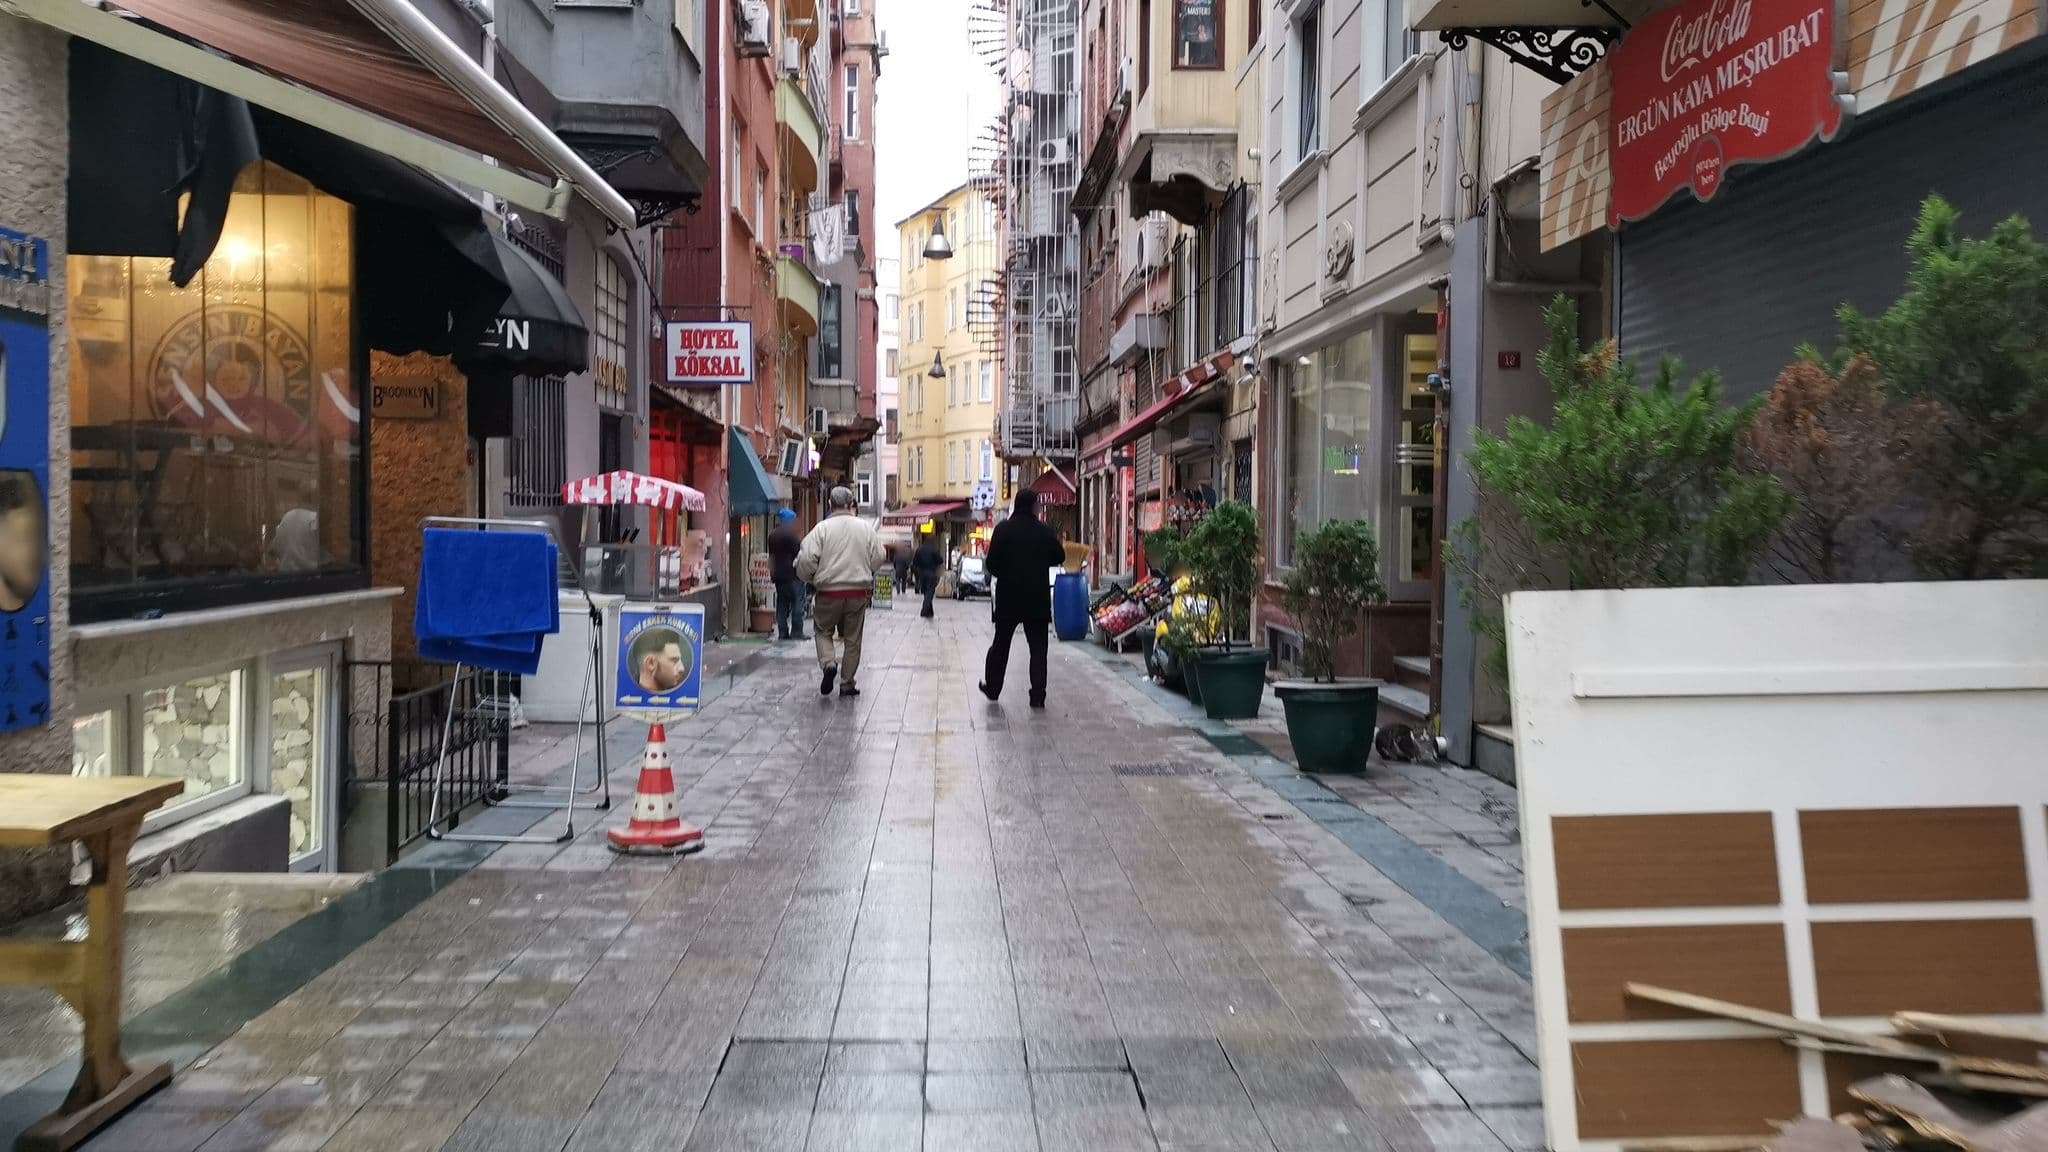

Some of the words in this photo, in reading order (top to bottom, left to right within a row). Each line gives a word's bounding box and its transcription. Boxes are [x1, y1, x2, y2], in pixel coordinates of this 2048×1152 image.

[1618, 96, 1670, 147] ERGÜN
[1673, 73, 1713, 118] KAYA
[1716, 8, 1824, 94] MEŞRUBAT
[1655, 123, 1700, 181] Beyoğlu
[1701, 106, 1736, 134] Bölge
[1738, 103, 1770, 137] Bayi
[675, 350, 745, 377] KÖKSAL
[680, 329, 738, 350] HOTEL
